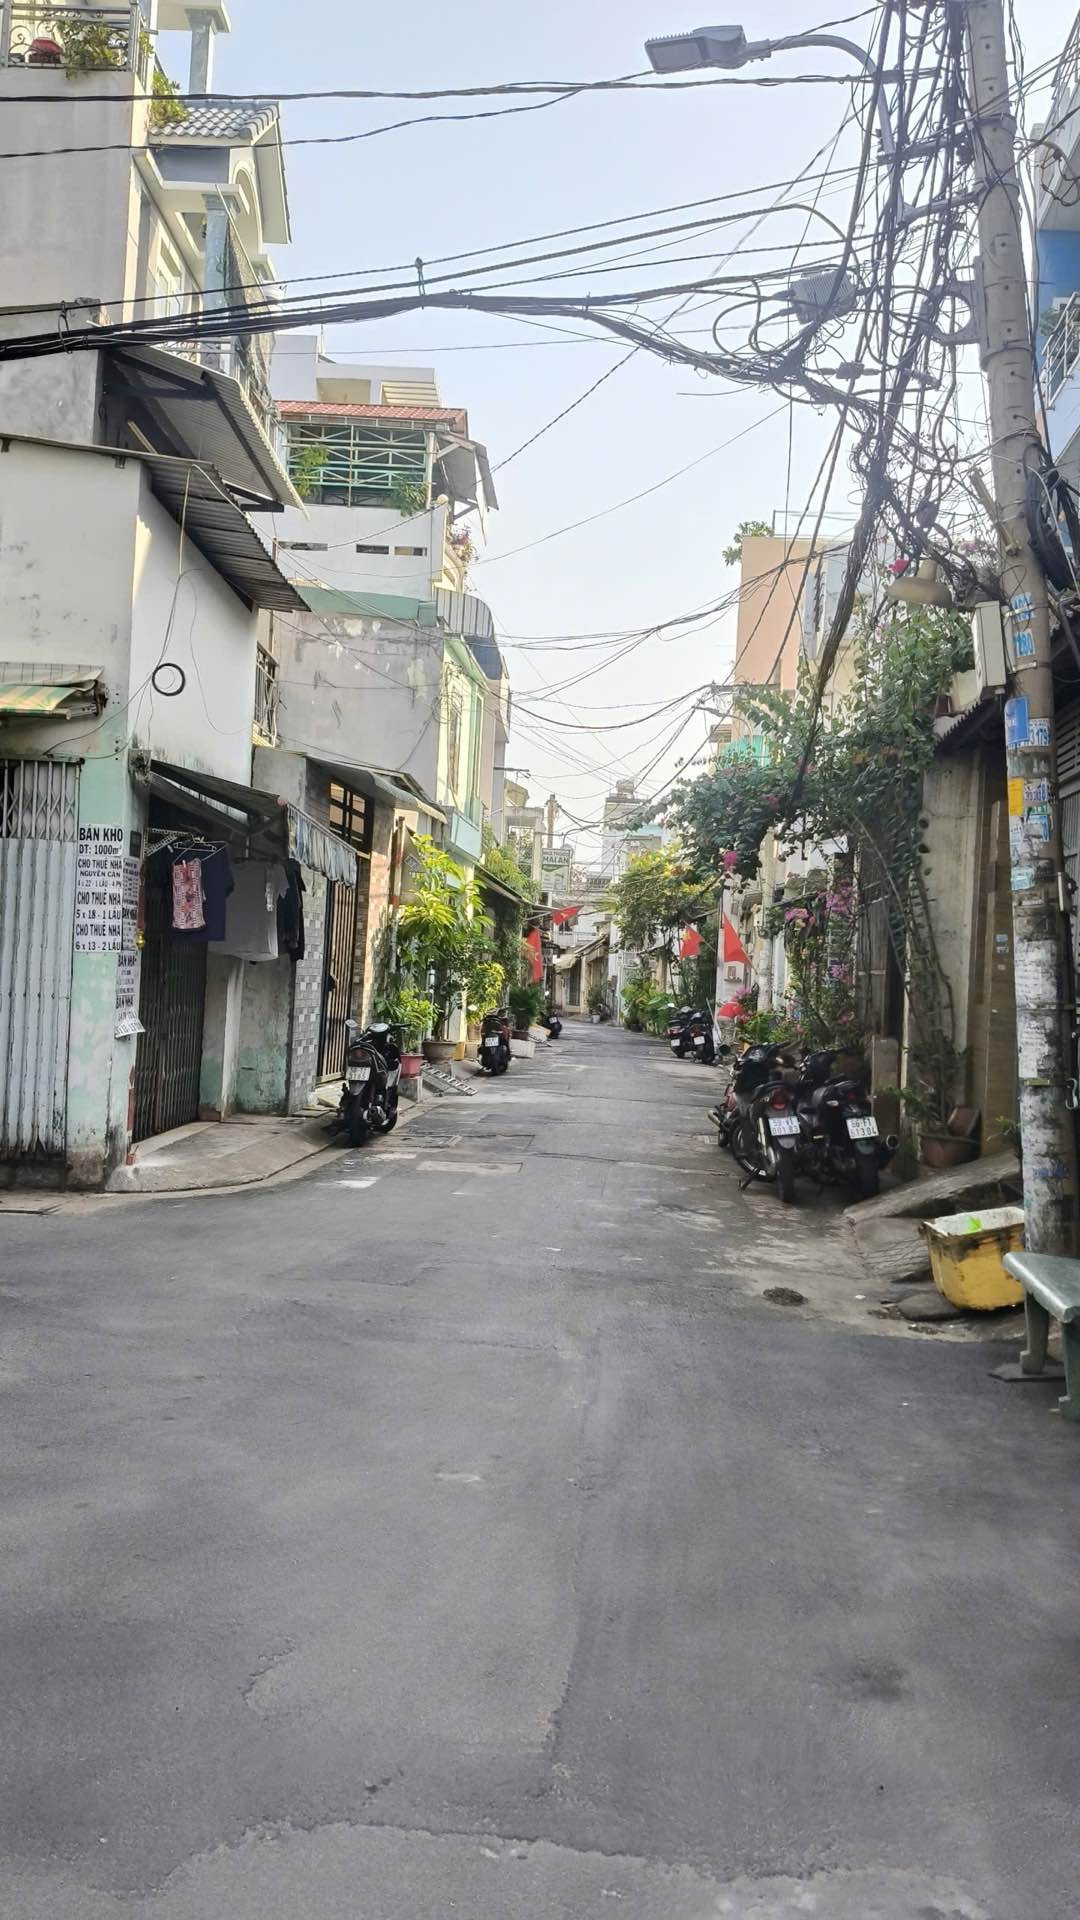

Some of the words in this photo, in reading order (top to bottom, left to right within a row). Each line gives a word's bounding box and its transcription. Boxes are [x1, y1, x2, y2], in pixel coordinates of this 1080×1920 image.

[104, 828, 123, 842] KHO
[78, 858, 90, 868] CHO
[77, 891, 89, 904] CHO
[76, 909, 80, 918] 5
[88, 909, 96, 919] 18
[76, 923, 88, 936] CHO
[76, 941, 80, 950] 6
[88, 941, 96, 950] 13
[102, 941, 106, 950] 2
